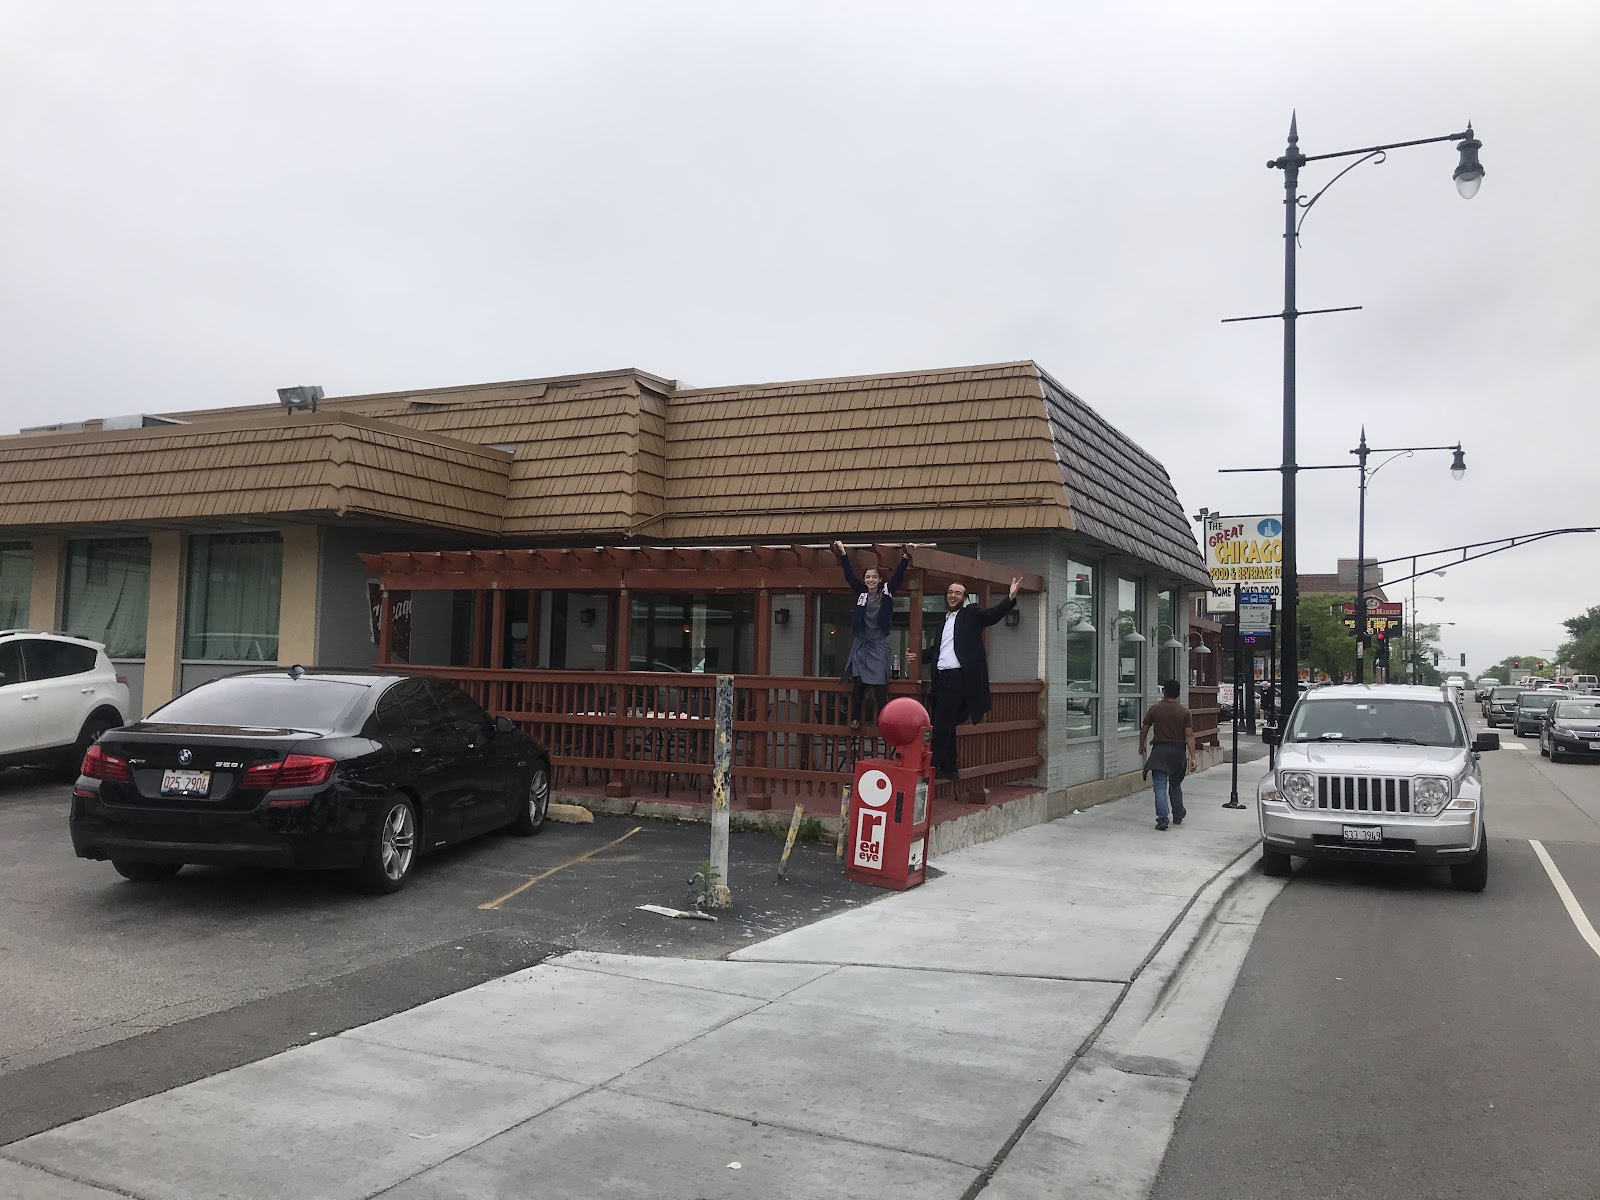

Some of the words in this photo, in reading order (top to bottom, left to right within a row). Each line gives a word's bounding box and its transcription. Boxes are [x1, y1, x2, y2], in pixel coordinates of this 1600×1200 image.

[1207, 521, 1223, 531] THE
[1208, 524, 1244, 547] GREAT
[1215, 540, 1282, 564] CHICAGO
[1209, 567, 1229, 580] FOOD
[1230, 567, 1236, 580] &
[1238, 566, 1273, 580] BEVERAGE
[185, 777, 207, 791] 2904
[1344, 830, 1358, 840] S33
[1362, 830, 1381, 841] 3949
[859, 852, 879, 862] eye
